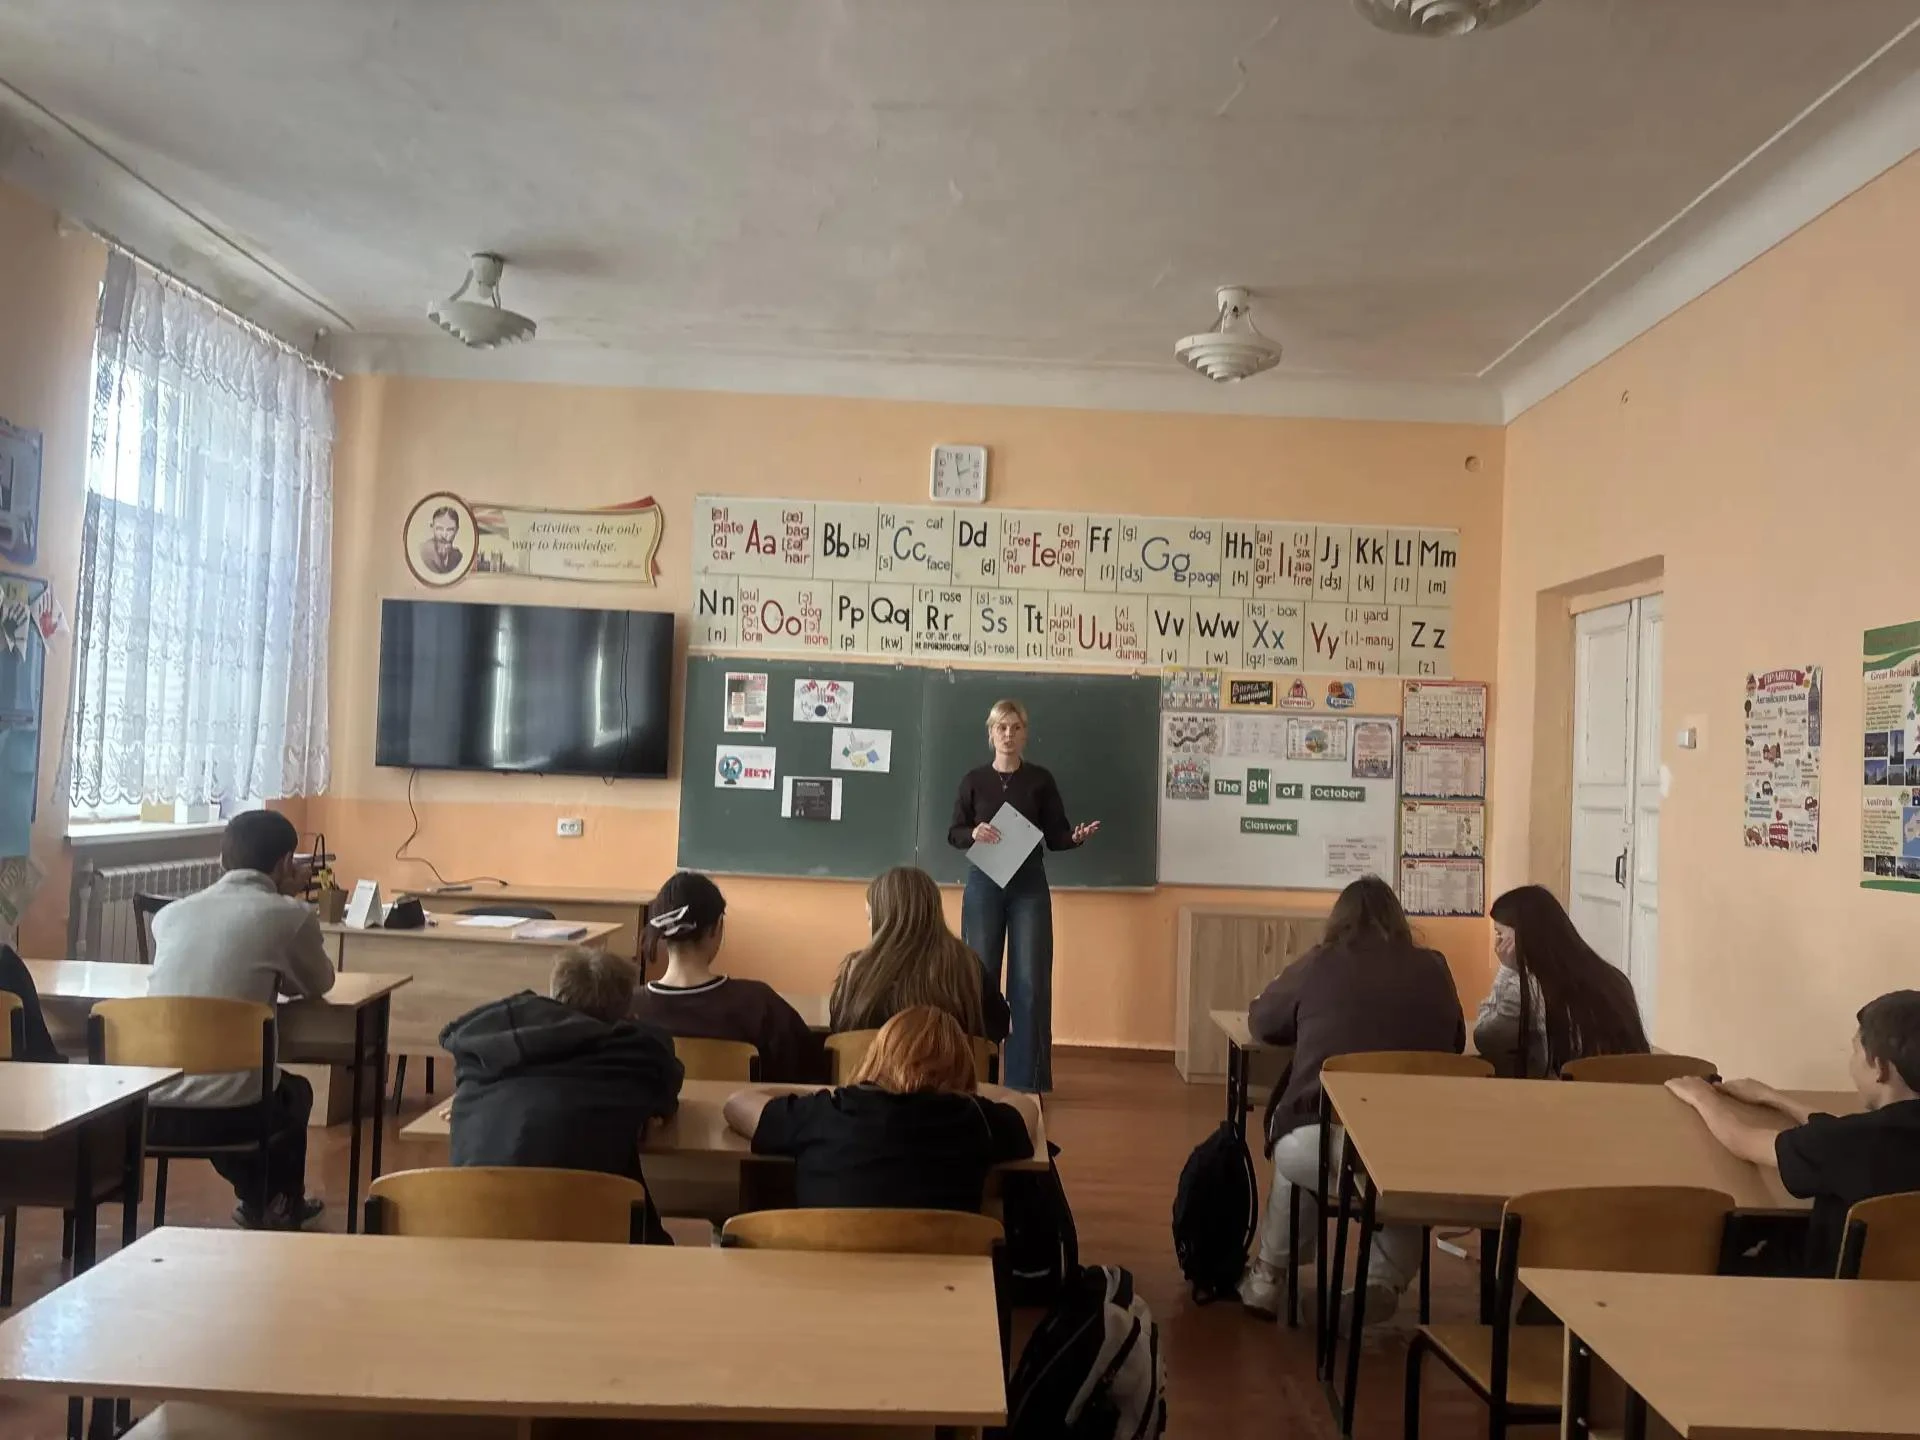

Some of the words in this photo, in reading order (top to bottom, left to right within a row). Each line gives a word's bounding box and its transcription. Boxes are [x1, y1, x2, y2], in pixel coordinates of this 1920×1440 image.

[528, 521, 581, 535] Activities
[596, 521, 612, 535] the
[616, 521, 643, 537] only
[713, 521, 744, 536] plate
[926, 516, 943, 529] cat
[745, 519, 777, 555] Aa
[786, 524, 810, 540] bag
[823, 522, 850, 558] Bb
[959, 520, 988, 547] Dd
[1009, 532, 1031, 546] tree
[1089, 526, 1113, 553] Ff
[1189, 526, 1212, 545] dog
[511, 540, 534, 553] way
[537, 540, 549, 551] to
[893, 526, 926, 562] Cc
[1032, 532, 1057, 567] Ee
[1060, 538, 1080, 551] pen
[1225, 531, 1253, 559] Hh
[1320, 535, 1339, 570] Jj
[1356, 537, 1384, 565] Kk
[713, 550, 735, 561] car
[785, 551, 811, 565] hair
[1141, 536, 1191, 583] Gg
[1296, 548, 1310, 559] six
[1420, 540, 1457, 568] Mm
[926, 556, 951, 571] face
[1008, 560, 1027, 575] her
[1060, 563, 1084, 577] here
[1188, 570, 1220, 588] page
[1256, 571, 1276, 589] girl
[1293, 573, 1312, 587] fire
[700, 588, 734, 616] Nn
[940, 591, 962, 603] rose
[999, 595, 1013, 605] six
[761, 600, 802, 636] Oo
[800, 602, 822, 621] dog
[839, 595, 865, 629] Pp
[871, 597, 910, 632] Qq
[927, 605, 954, 630] Rr
[1023, 604, 1044, 634] Tt
[1277, 604, 1298, 617] box
[1363, 607, 1388, 624] yard
[981, 607, 1008, 633] Ss
[1050, 617, 1076, 632] pupil
[1115, 617, 1135, 632] bus
[1154, 609, 1185, 637] Vv
[1196, 611, 1240, 639] Ww
[742, 628, 763, 643] form
[805, 634, 829, 646] more
[1078, 613, 1112, 650] Uu
[1252, 619, 1285, 650] Xx
[994, 643, 1015, 654] rose
[1311, 621, 1340, 660] Yy
[1366, 635, 1394, 651] many
[1051, 644, 1074, 657] turn
[1115, 646, 1147, 664] during
[1273, 655, 1298, 667] exam
[1367, 660, 1385, 675] my
[1889, 668, 1911, 678] Britain
[1217, 780, 1239, 793] The
[1249, 780, 1268, 793] 8th
[1282, 785, 1297, 796] of
[1314, 787, 1361, 799] October
[1866, 798, 1893, 807] Australia
[1244, 820, 1293, 831] Classwork
